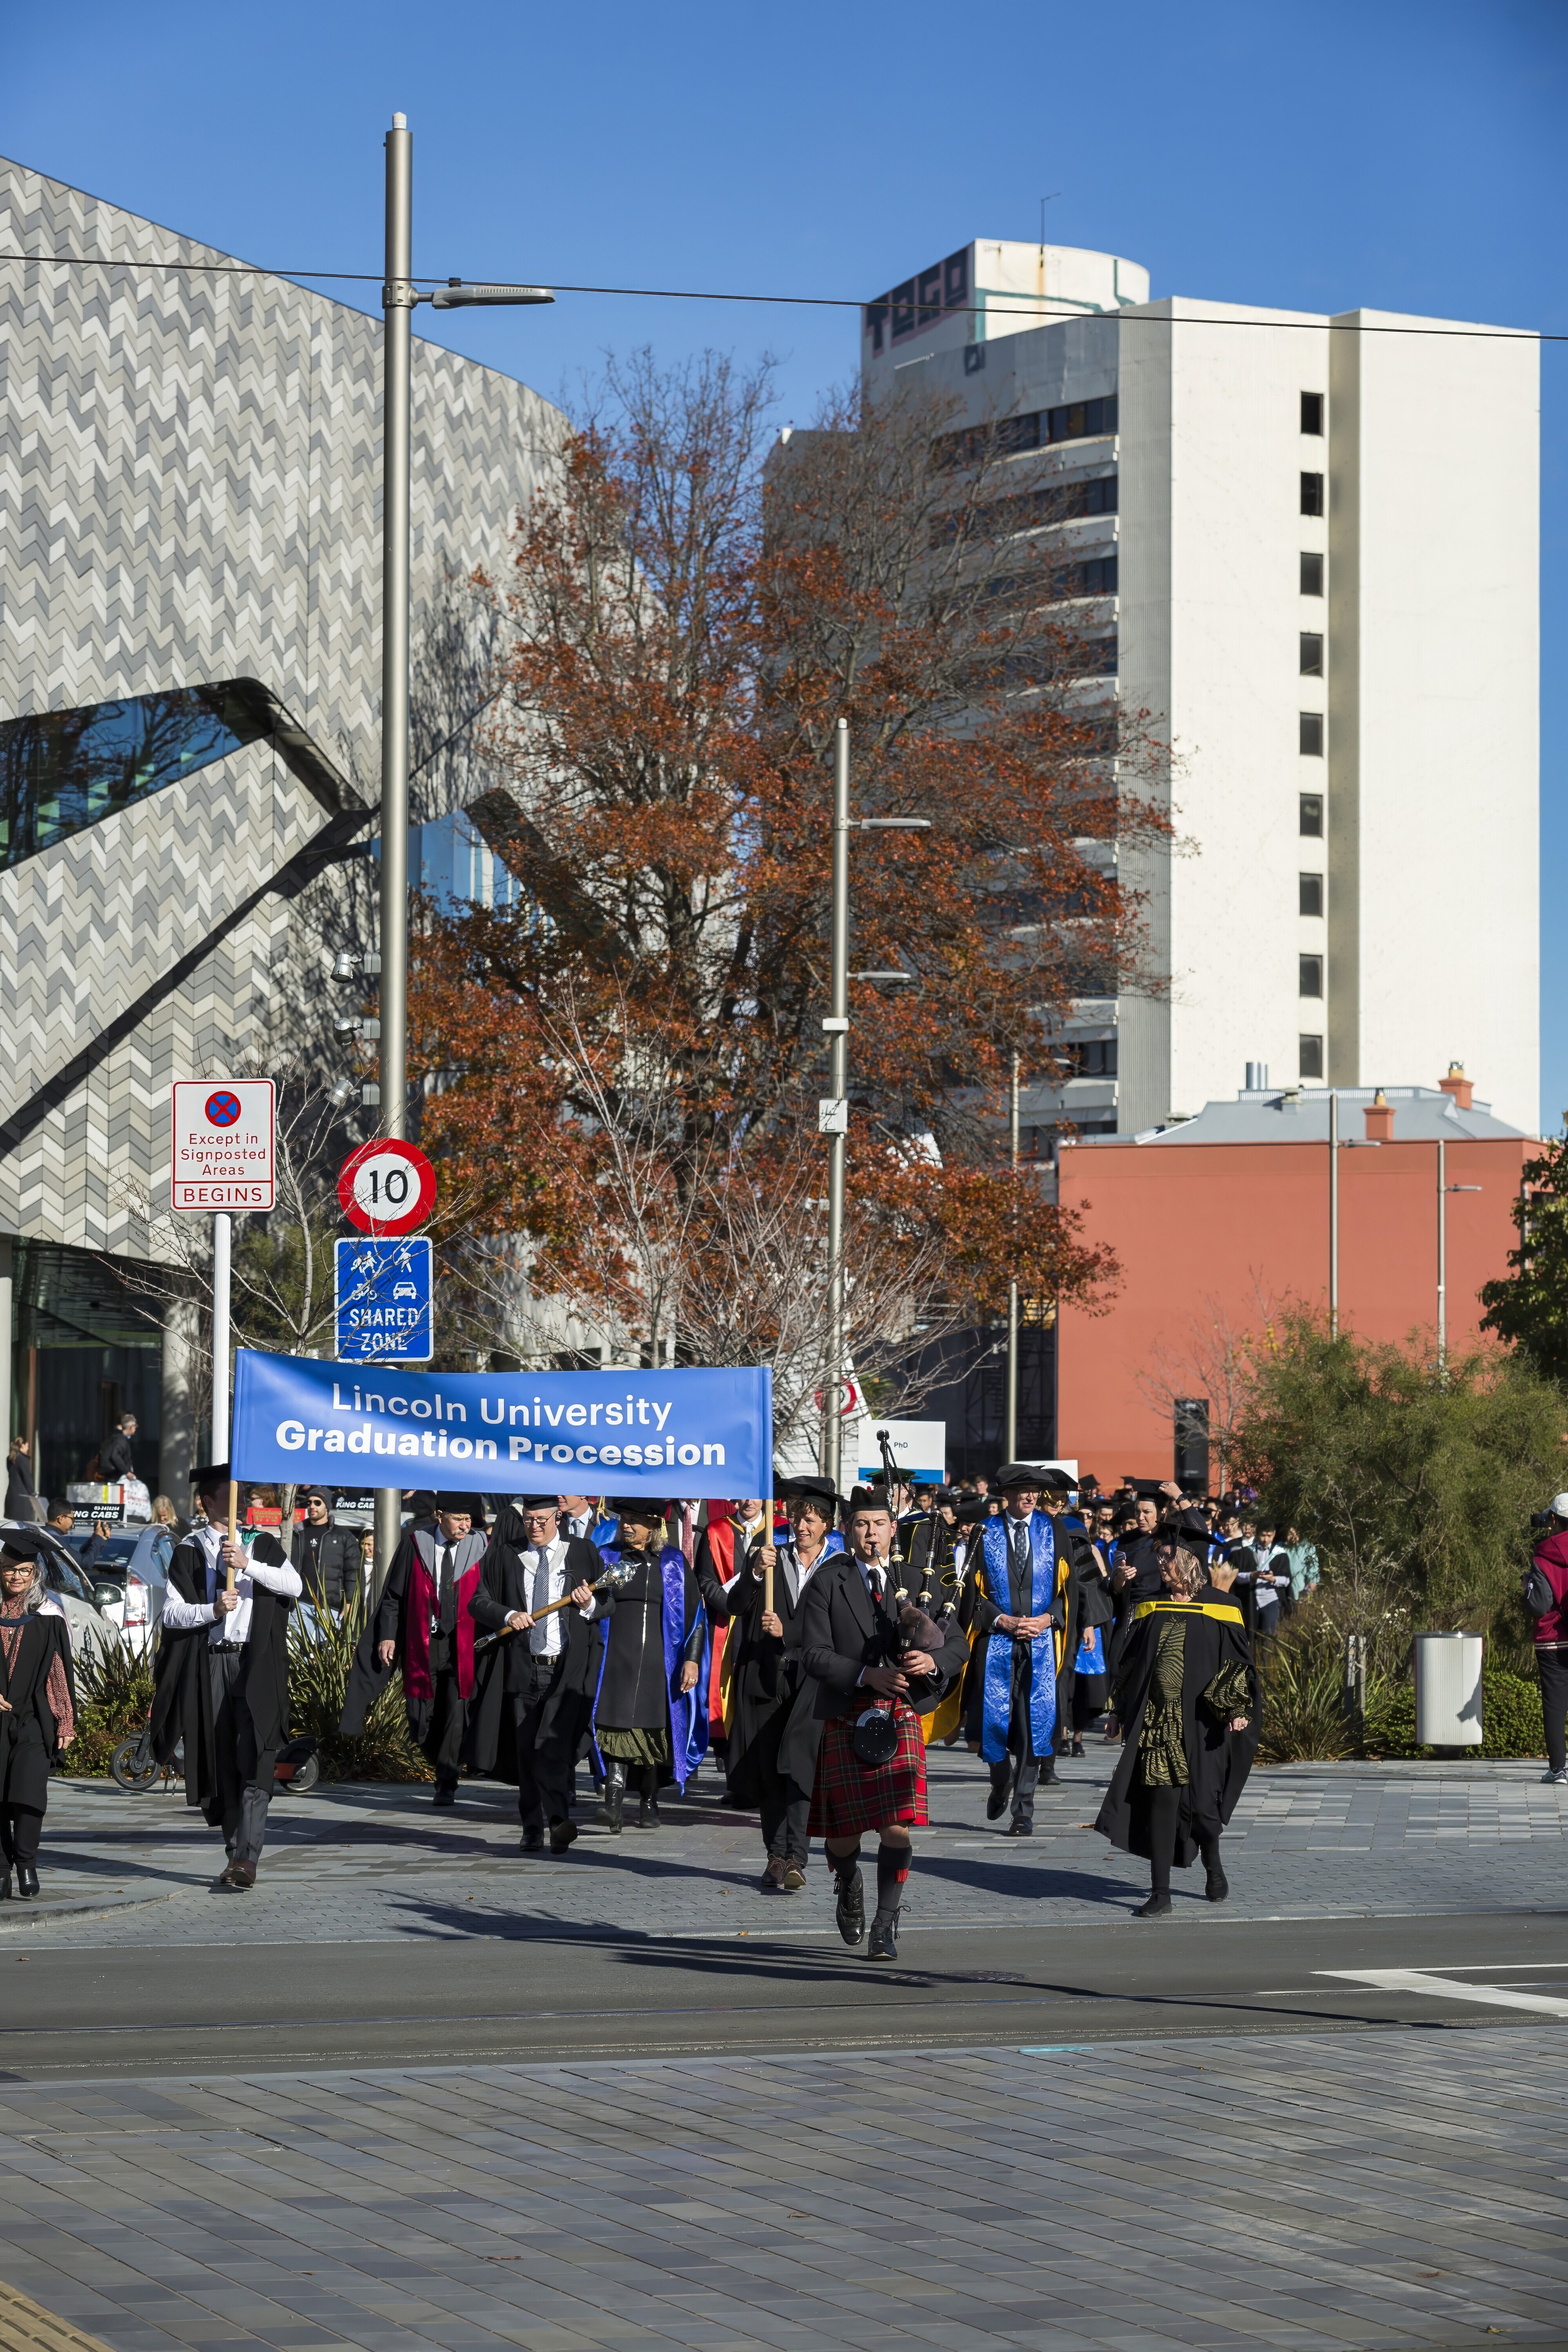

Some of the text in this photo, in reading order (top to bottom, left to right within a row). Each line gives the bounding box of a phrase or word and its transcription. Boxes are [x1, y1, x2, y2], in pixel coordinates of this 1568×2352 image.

[189, 1133, 258, 1147] Except in
[181, 1148, 265, 1162] Signposted
[202, 1164, 245, 1175] Areas
[184, 1187, 262, 1202] BEGINS
[369, 1169, 408, 1203] 10
[349, 1308, 418, 1327] SHARED
[361, 1333, 408, 1351] ZONE
[333, 1383, 673, 1431] Lincoln University
[276, 1419, 725, 1466] Graduation Procession
